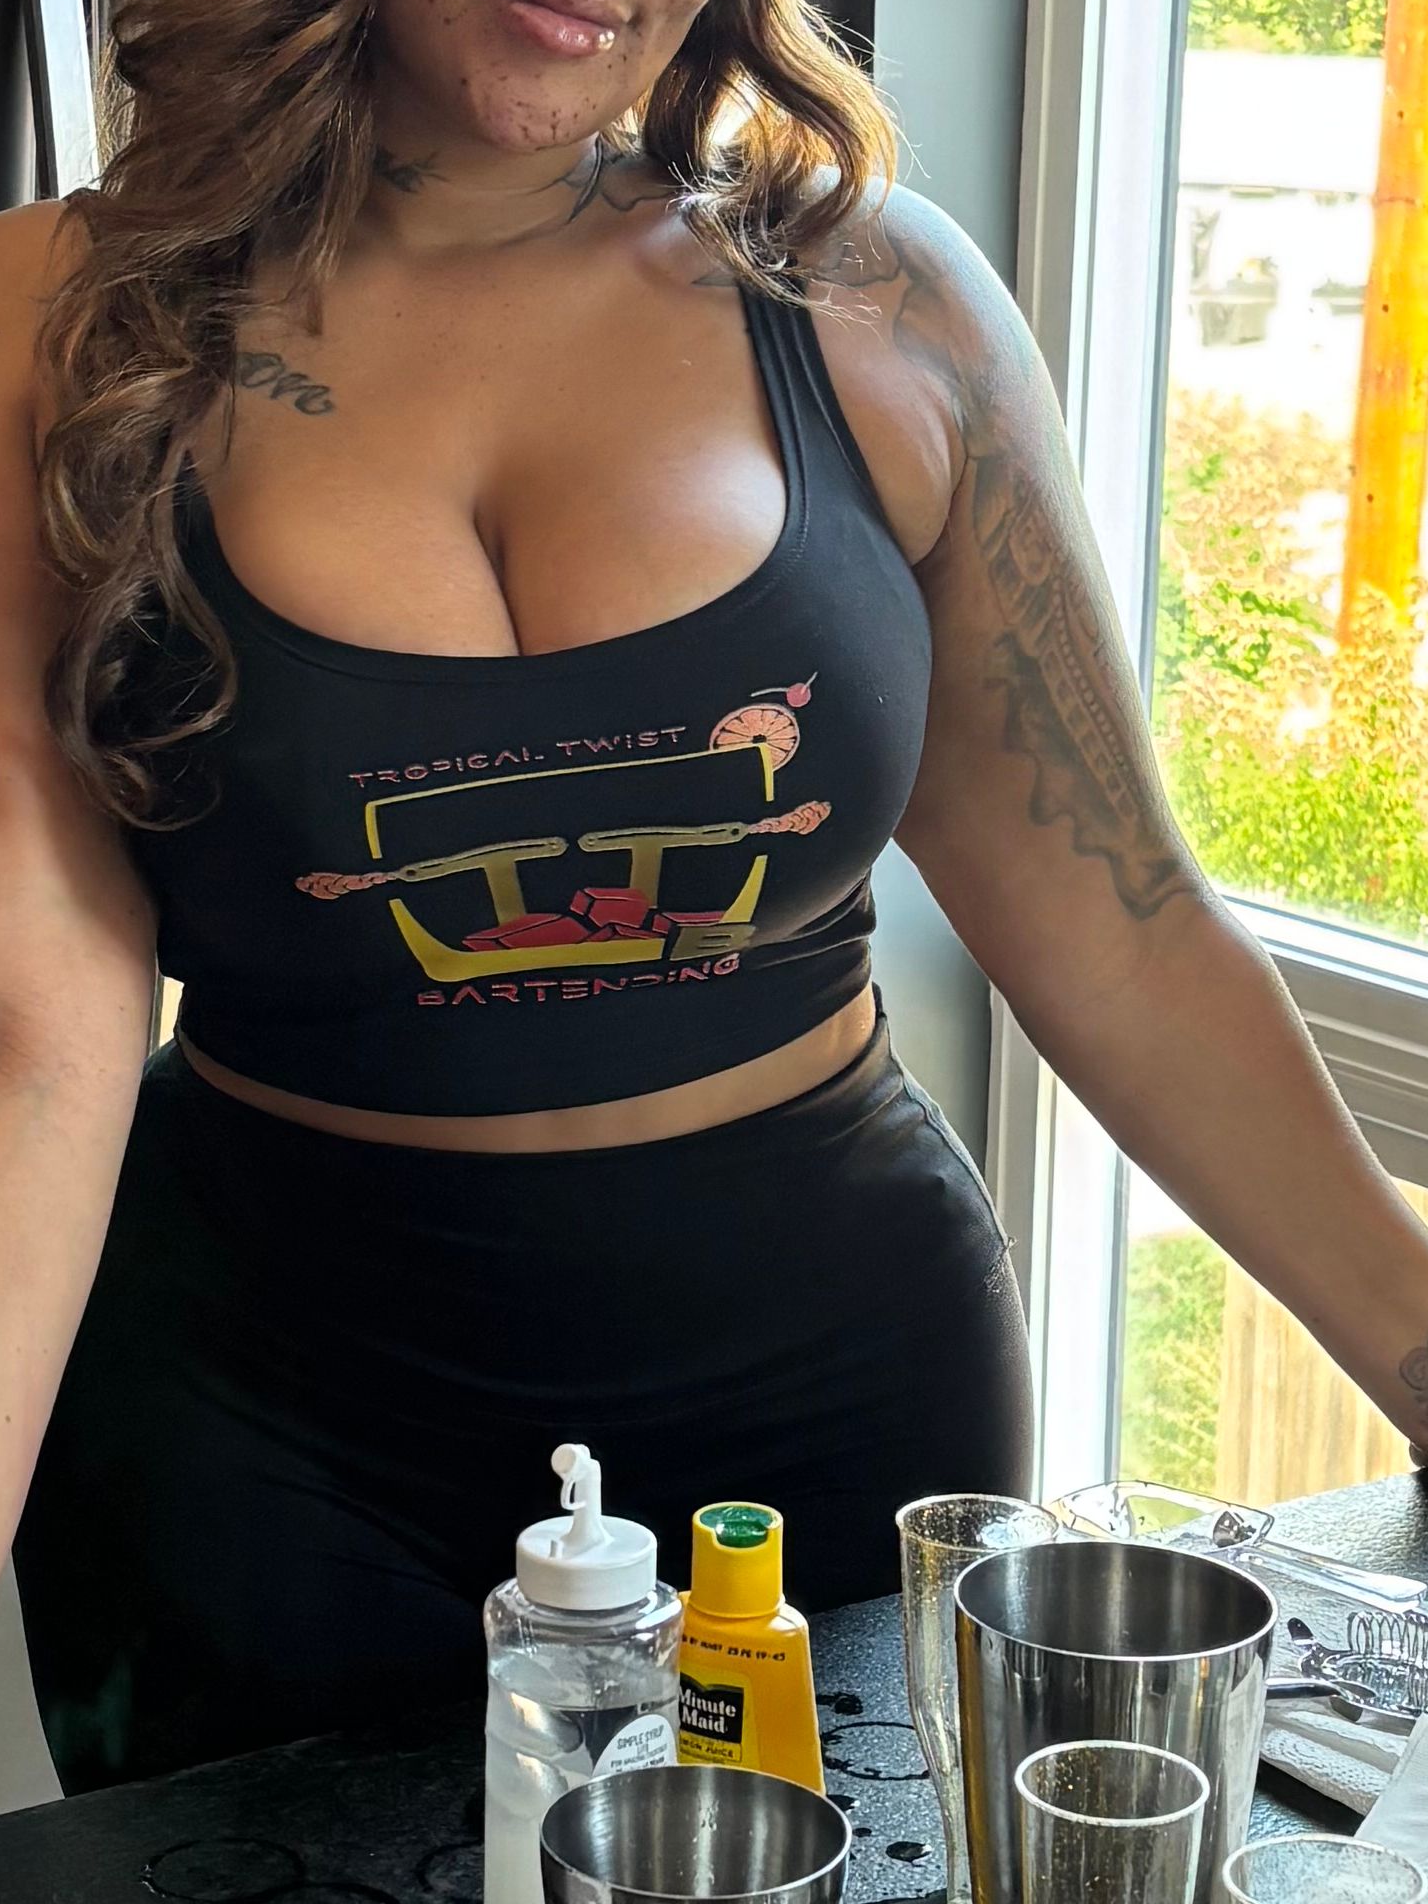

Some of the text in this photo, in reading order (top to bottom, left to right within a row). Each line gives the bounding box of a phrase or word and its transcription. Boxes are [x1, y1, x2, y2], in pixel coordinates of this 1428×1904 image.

[348, 725, 687, 789] TROPICAL TWIST
[416, 952, 741, 1007] BARTENDING
[679, 1685, 737, 1718] Minute
[682, 1705, 726, 1734] Maid
